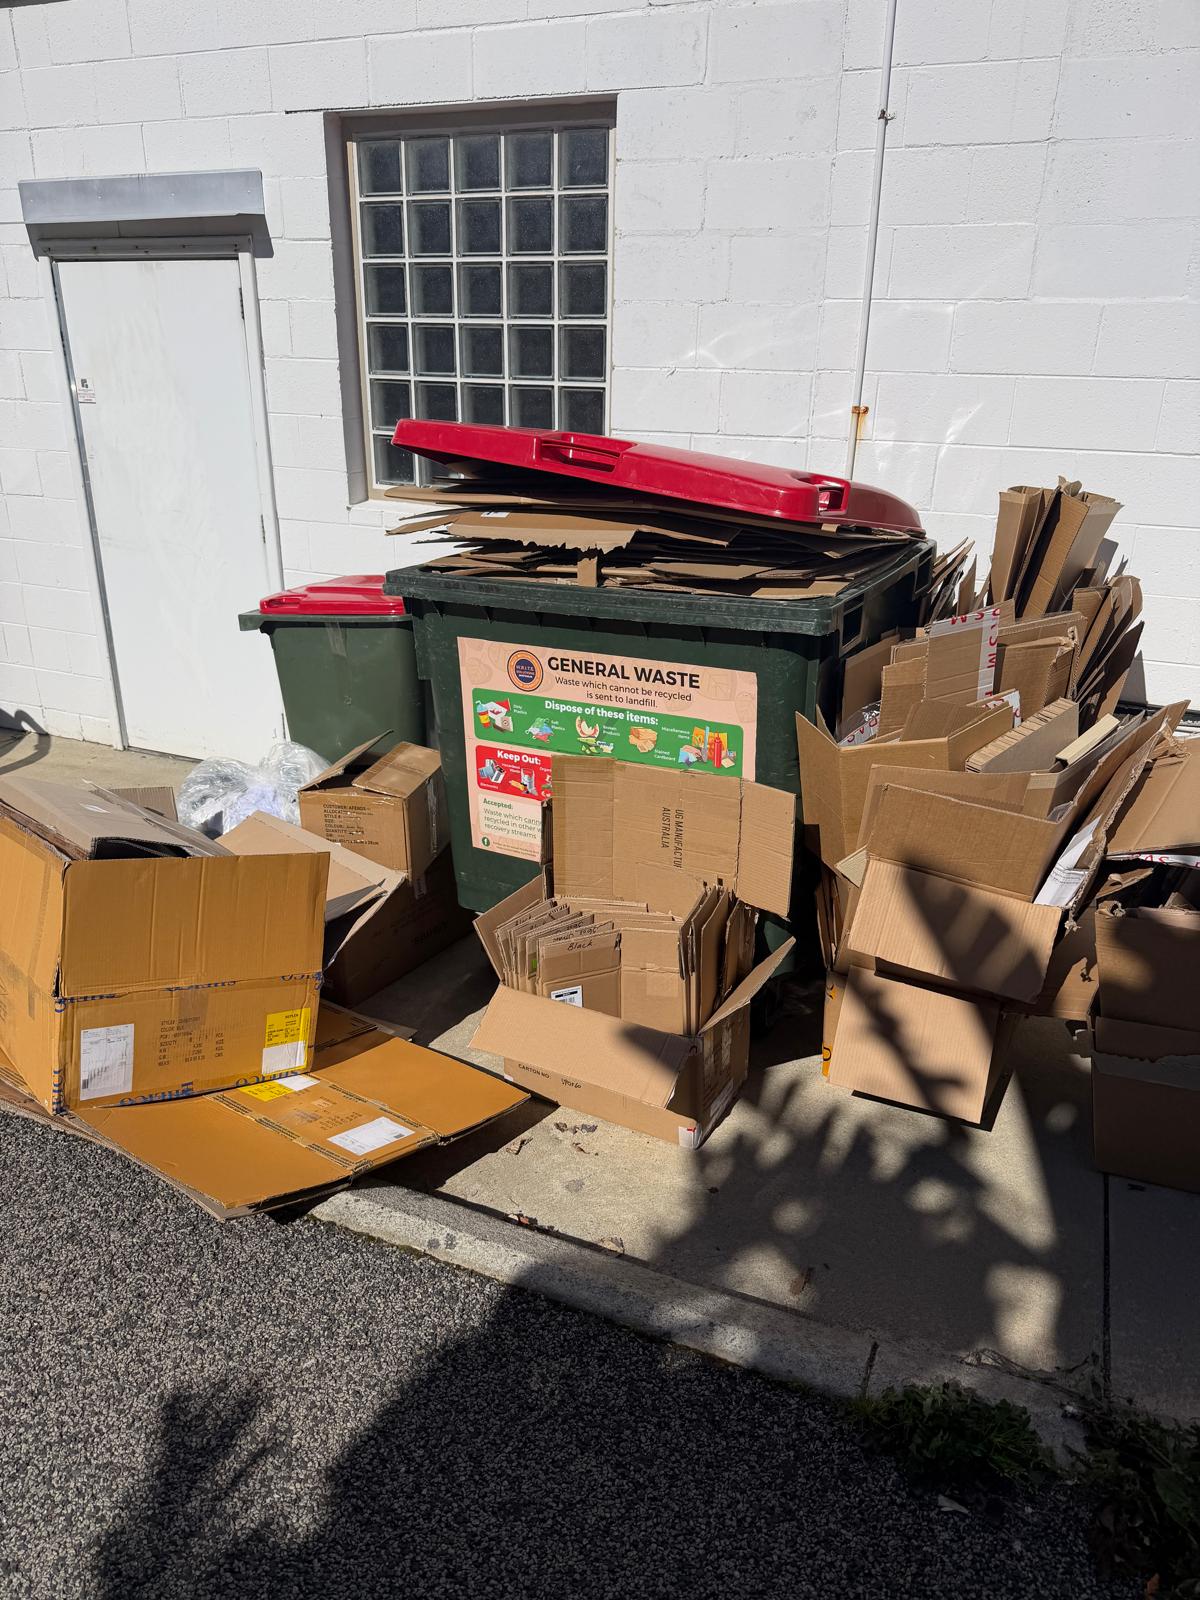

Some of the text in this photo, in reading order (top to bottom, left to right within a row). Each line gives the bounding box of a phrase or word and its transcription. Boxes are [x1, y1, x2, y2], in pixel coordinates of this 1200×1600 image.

[547, 656, 700, 689] GENERAL WASTE
[555, 676, 692, 702] Waste which cannot be recycled
[586, 690, 658, 708] is sent to landfill.
[544, 700, 659, 726] Dispose of these items:
[497, 750, 541, 765] Keep Out:
[483, 798, 514, 810] Accepted:
[483, 808, 502, 817] Waste
[503, 812, 523, 822] which
[484, 815, 510, 827] recycled
[518, 824, 536, 832] other
[484, 823, 510, 834] recovery
[511, 828, 537, 839] streams
[661, 806, 671, 849] AUSTRALIA
[567, 940, 593, 951] Black
[518, 1063, 541, 1076] CARTON
